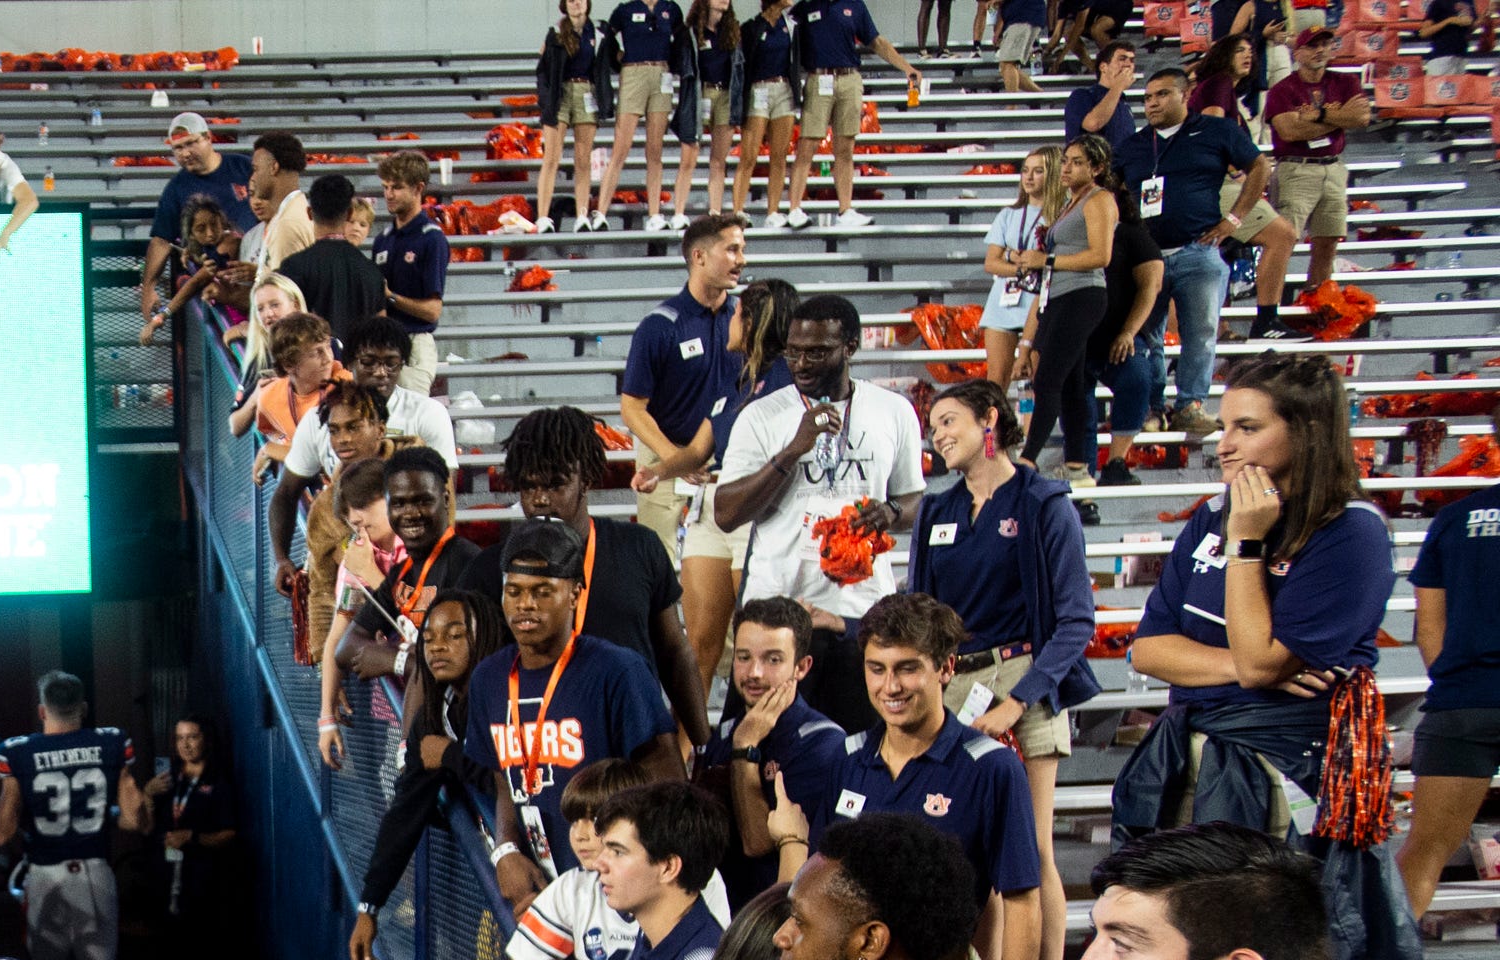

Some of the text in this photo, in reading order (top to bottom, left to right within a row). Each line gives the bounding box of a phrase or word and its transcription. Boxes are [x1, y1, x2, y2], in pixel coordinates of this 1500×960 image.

[1467, 509, 1500, 524] DO
[490, 718, 585, 767] TIGERS
[33, 768, 107, 836] 33
